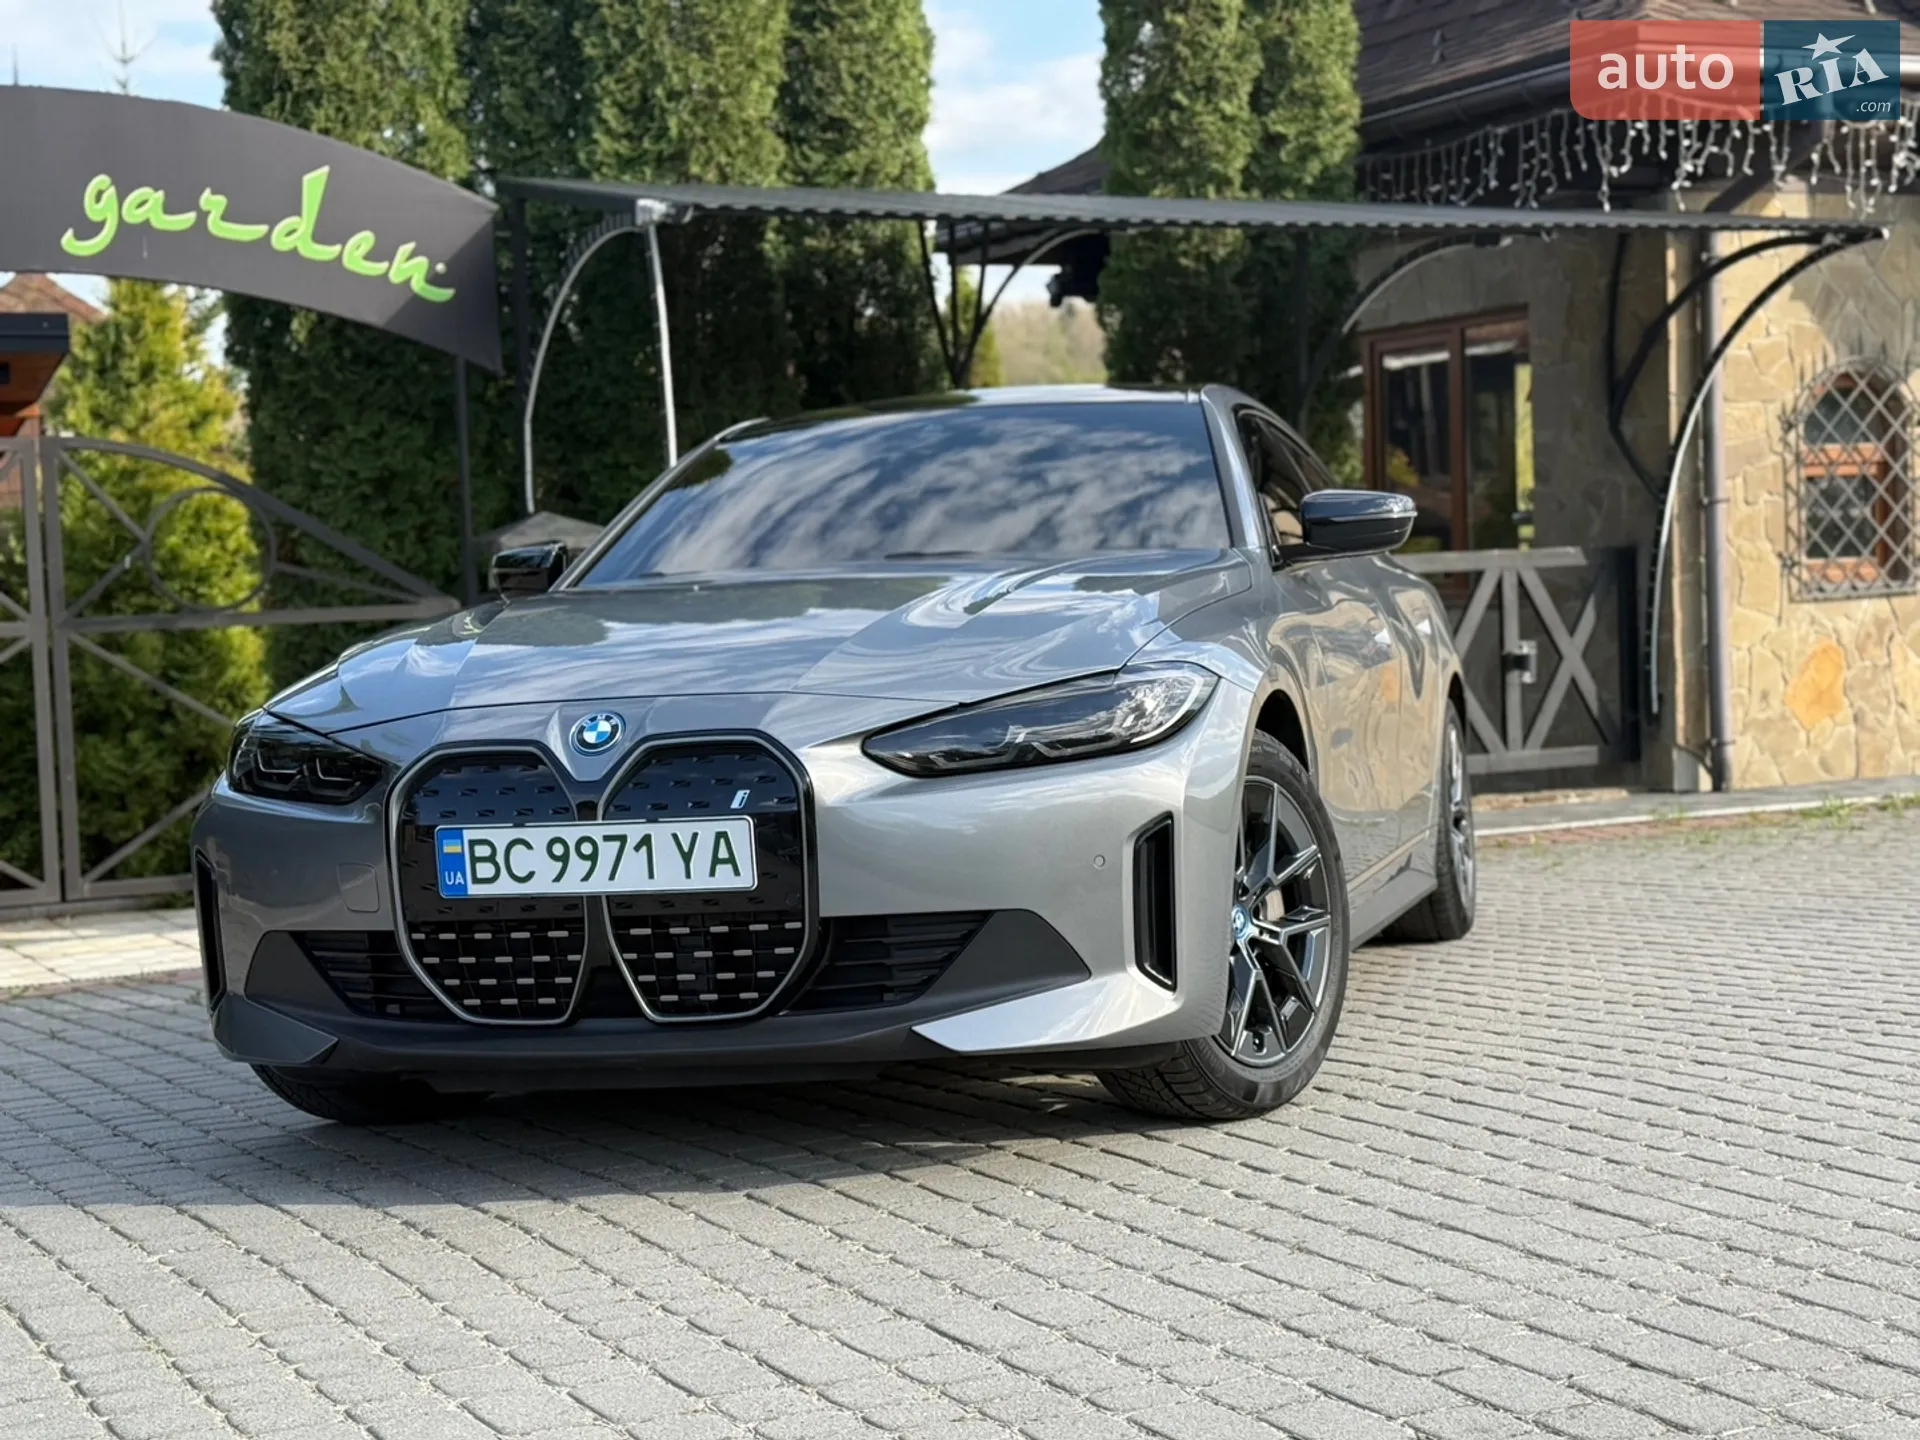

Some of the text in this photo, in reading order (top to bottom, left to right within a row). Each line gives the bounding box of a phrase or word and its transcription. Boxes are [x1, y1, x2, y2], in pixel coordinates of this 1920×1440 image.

[61, 165, 456, 301] garden
[445, 871, 465, 885] UA
[468, 830, 741, 885] BC 9971 YA
